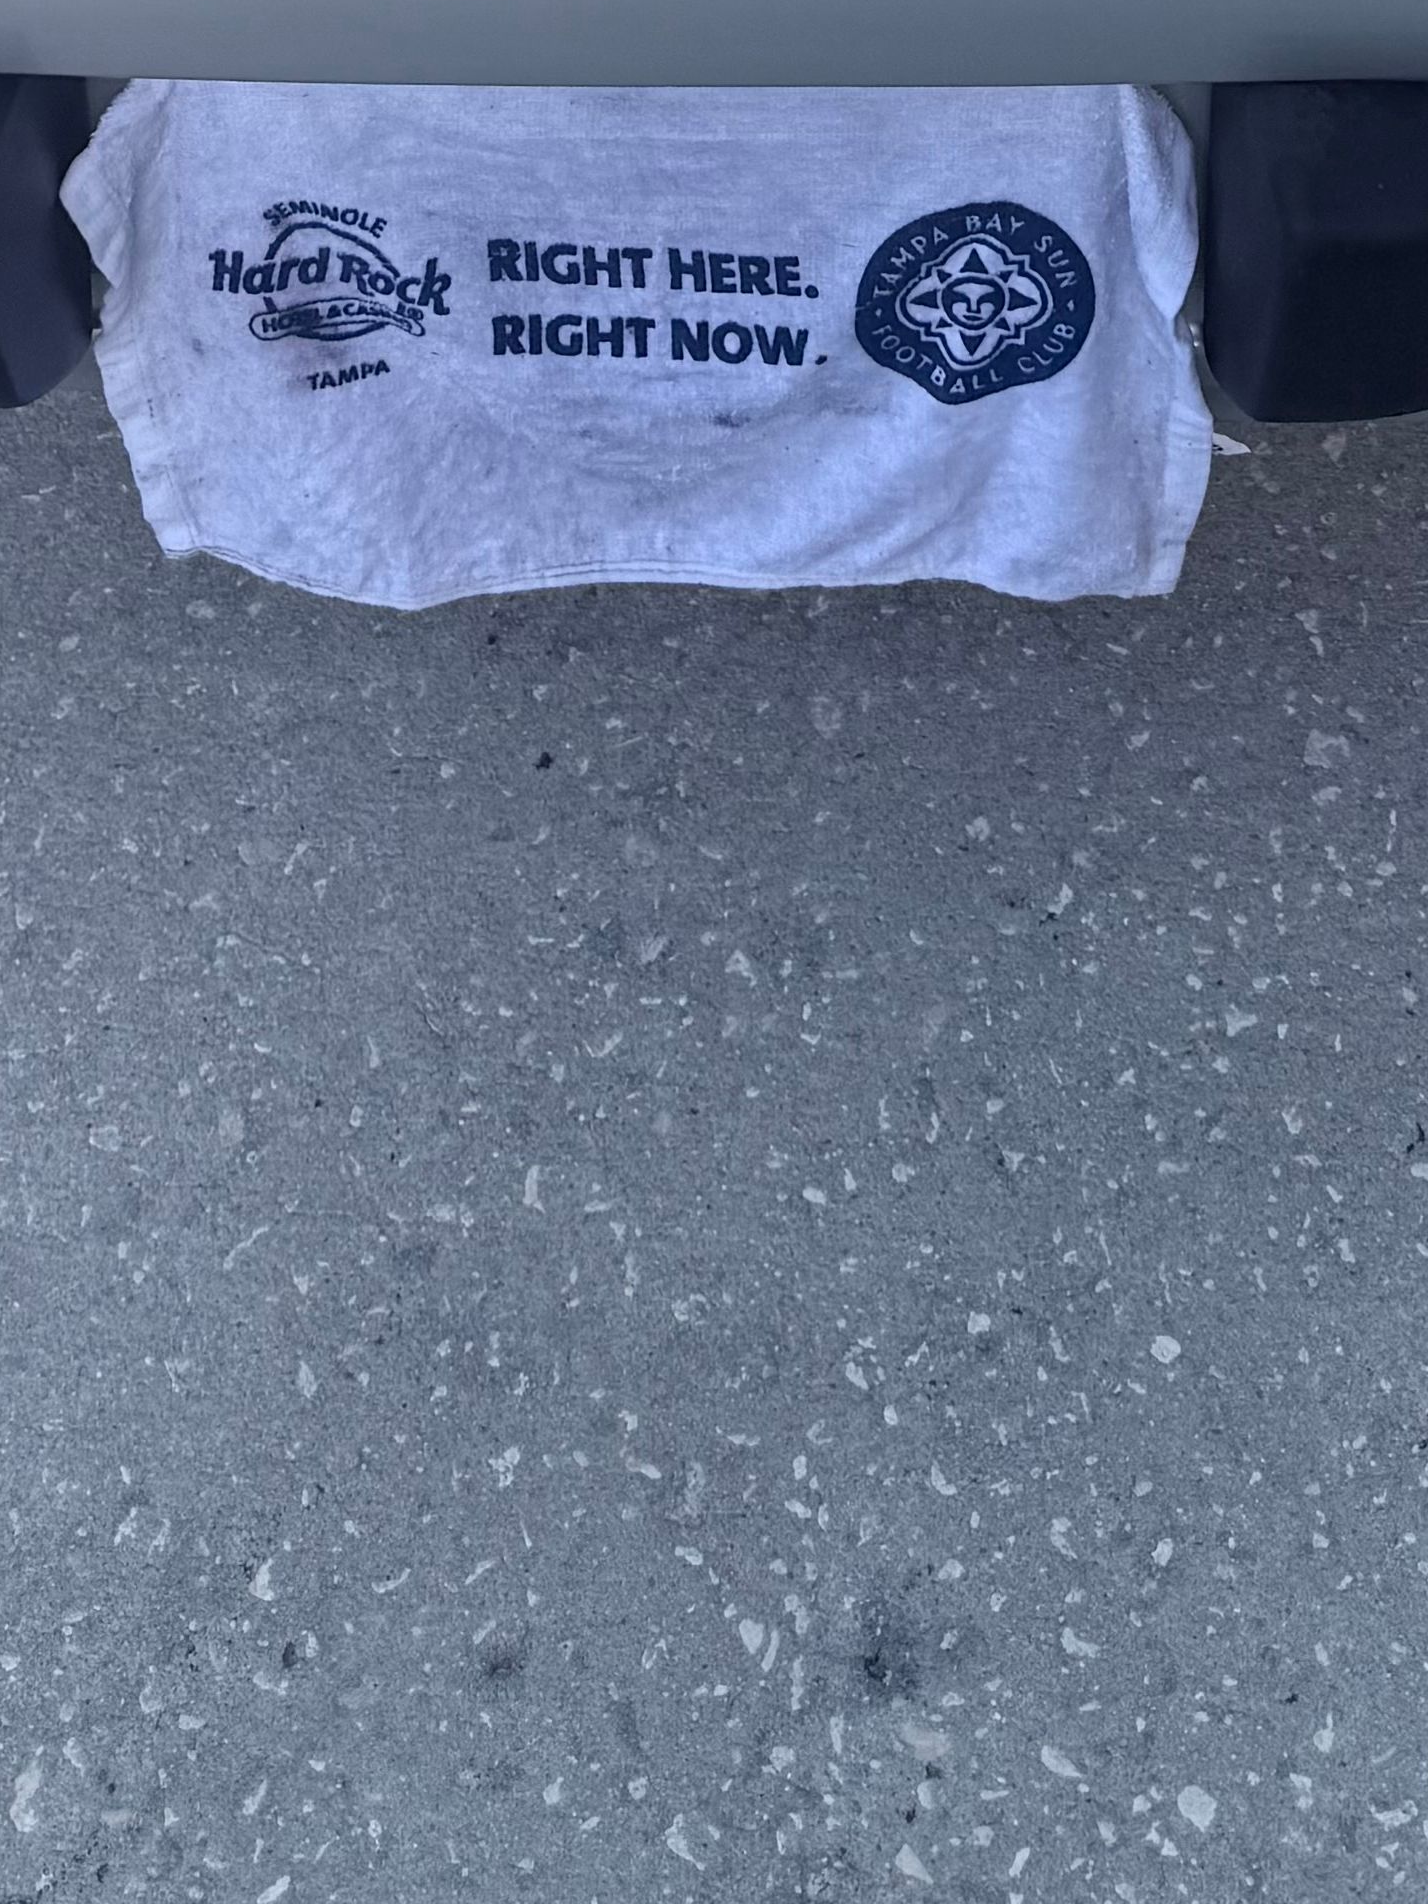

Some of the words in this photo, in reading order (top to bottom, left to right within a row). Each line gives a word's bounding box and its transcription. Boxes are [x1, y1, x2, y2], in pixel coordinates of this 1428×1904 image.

[263, 200, 387, 238] SEMINOLE
[209, 247, 331, 295] Hard
[337, 252, 452, 316] Rock
[487, 238, 653, 289] RIGHT
[668, 247, 819, 299] HERE.
[873, 227, 948, 298] TAMPA
[966, 213, 1025, 235] BAY
[1034, 235, 1077, 288] SUN
[492, 314, 656, 358] RIGHT
[872, 324, 1004, 393] FOOTBALL
[1018, 323, 1076, 372] CLUB
[307, 360, 390, 391] TAMPA
